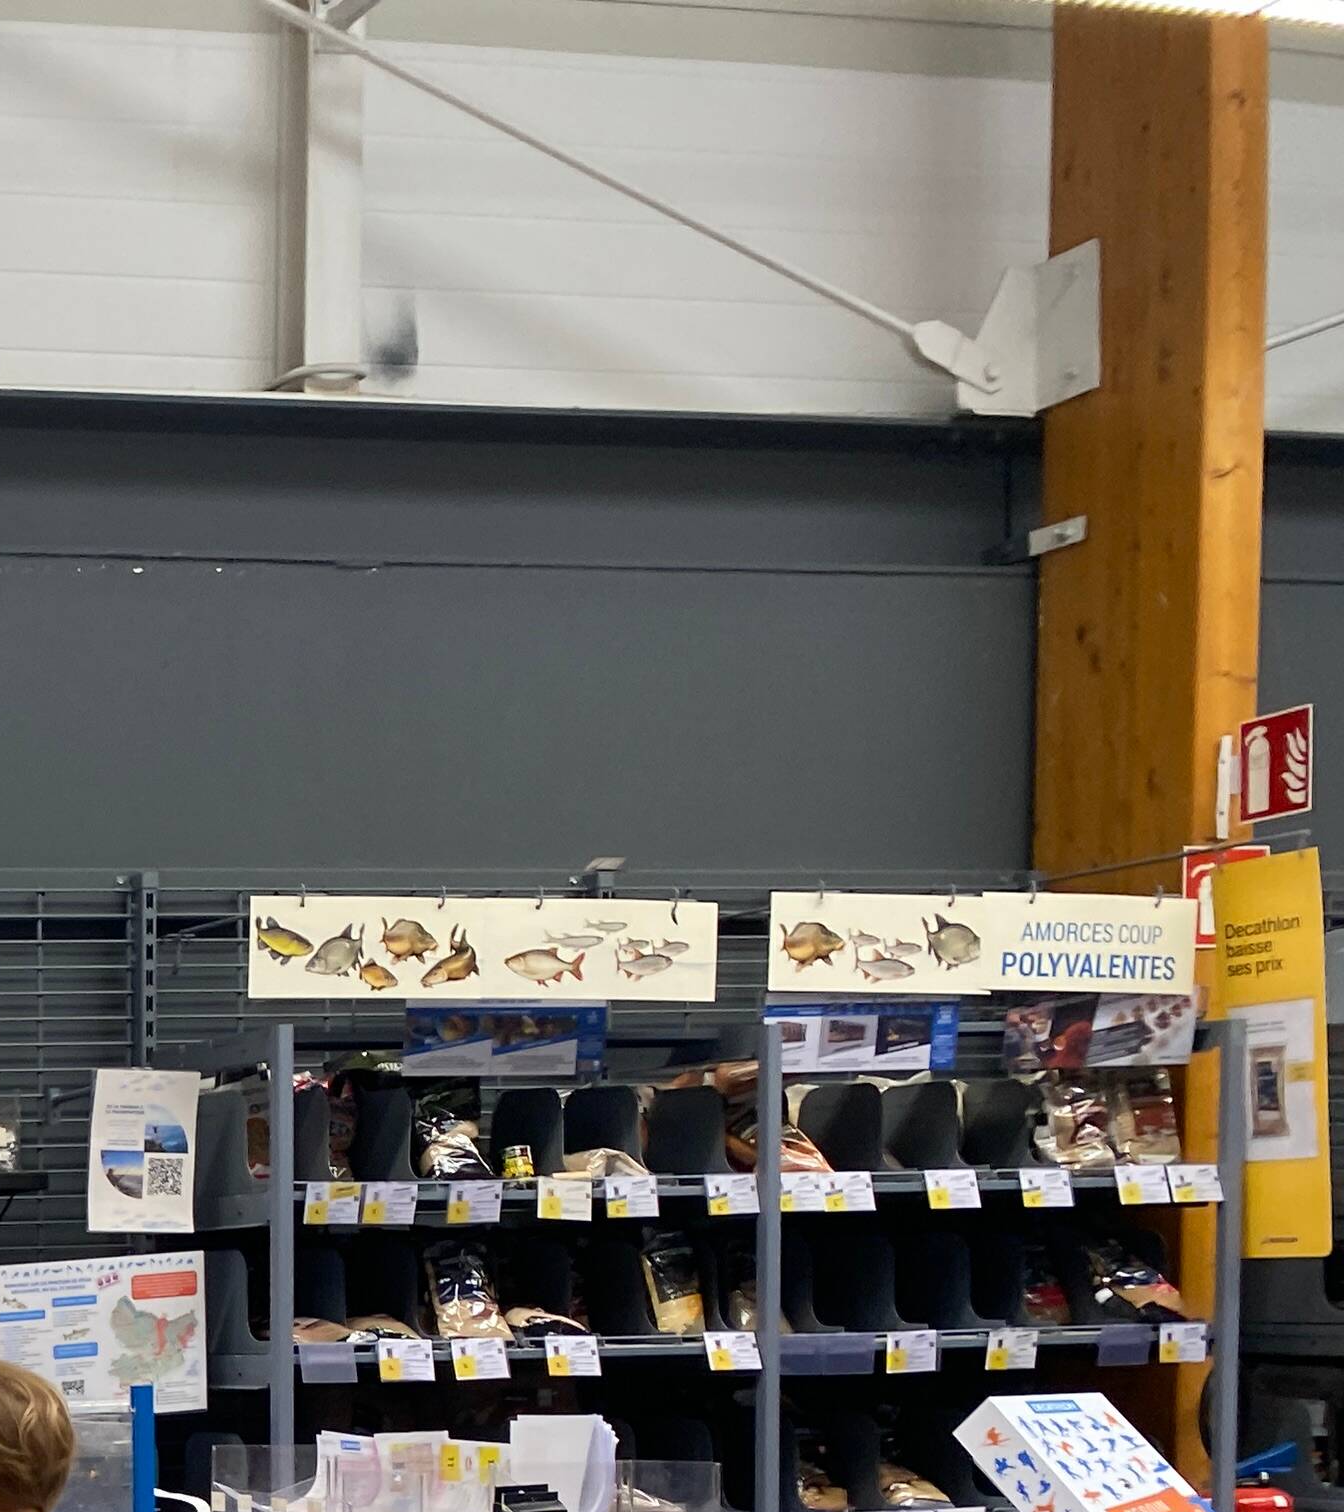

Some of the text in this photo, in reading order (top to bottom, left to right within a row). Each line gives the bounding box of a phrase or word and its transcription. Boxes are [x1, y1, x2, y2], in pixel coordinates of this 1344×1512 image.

[1019, 921, 1165, 946] AMORCES COUP
[1223, 916, 1301, 939] Decathlon
[1225, 940, 1273, 958] baisse
[1000, 951, 1178, 982] POLYVALENTES
[1226, 957, 1284, 979] ses prix
